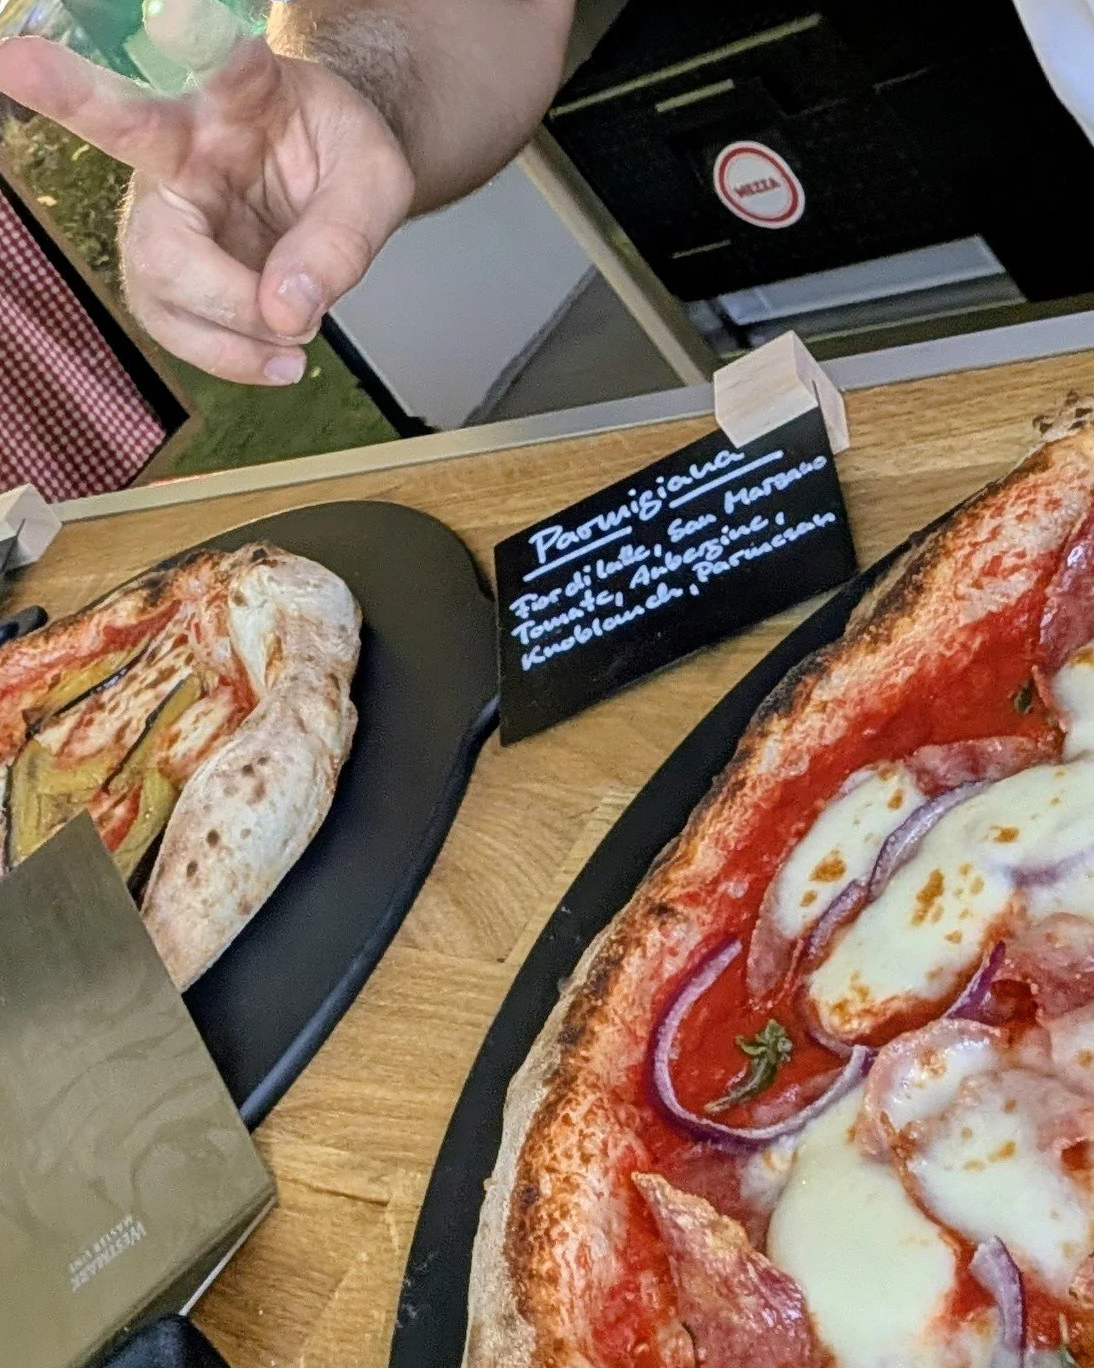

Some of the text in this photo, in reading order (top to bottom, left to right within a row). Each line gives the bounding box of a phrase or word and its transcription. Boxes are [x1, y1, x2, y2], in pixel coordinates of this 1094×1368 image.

[734, 177, 781, 199] MEZZA
[528, 449, 746, 565] Parmigiana
[667, 513, 718, 543] San
[723, 455, 828, 514] Marzano
